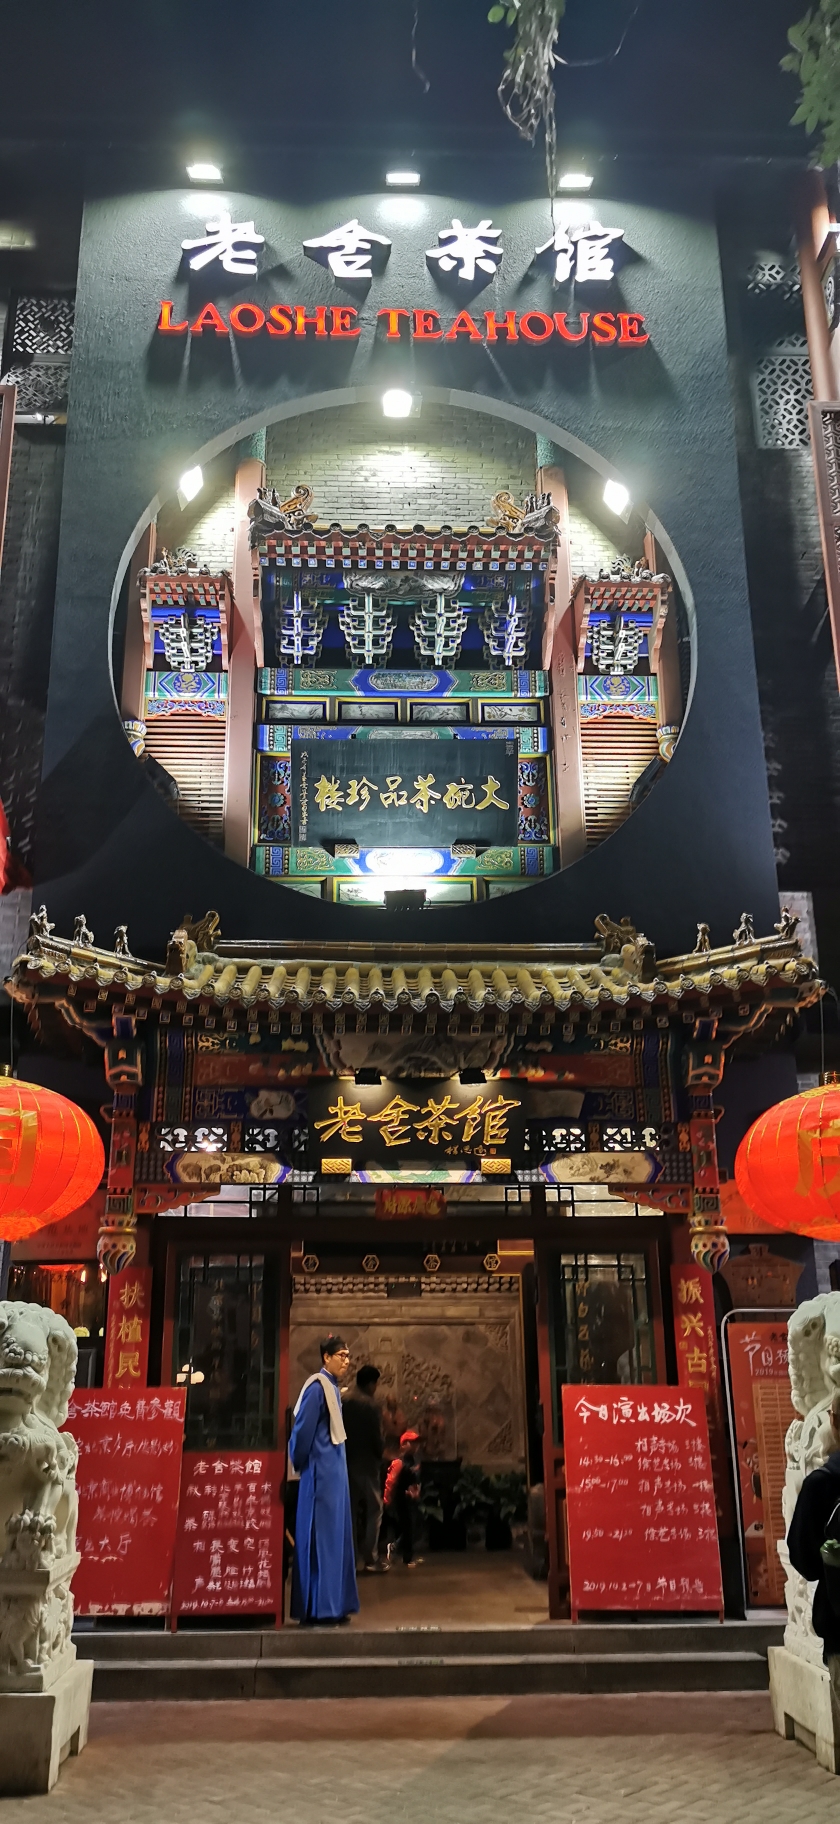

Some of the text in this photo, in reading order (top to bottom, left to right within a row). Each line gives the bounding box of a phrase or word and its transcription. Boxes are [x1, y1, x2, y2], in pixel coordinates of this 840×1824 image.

[182, 215, 624, 284] 老舍茶馆
[158, 300, 650, 345] LAOSHE TEAHOUSE
[314, 1094, 522, 1147] 老舍茶馆
[115, 1280, 145, 1389] 扶植民
